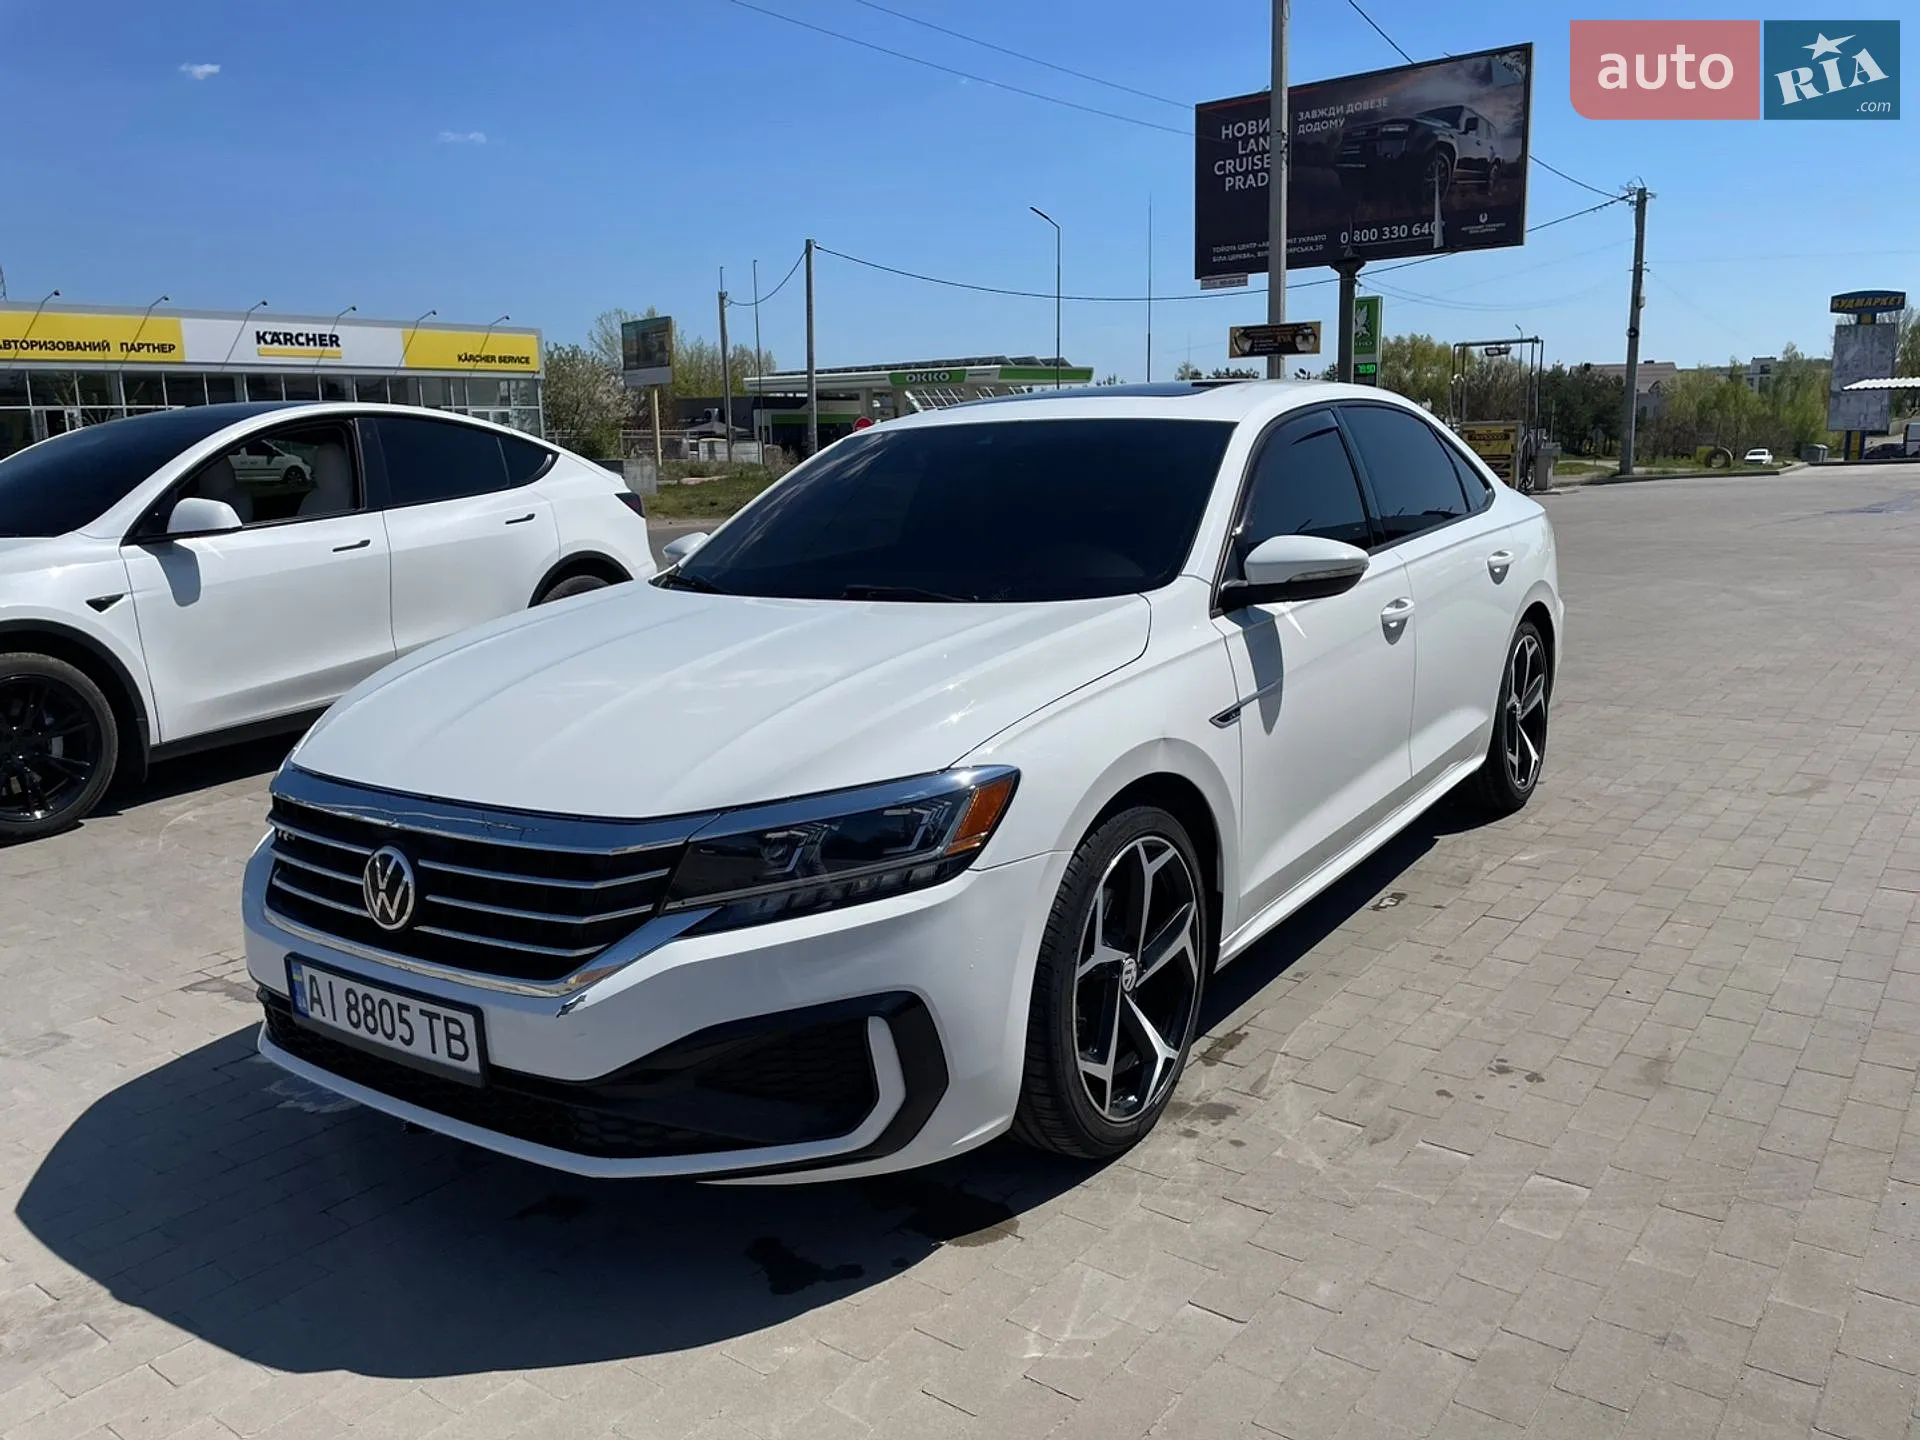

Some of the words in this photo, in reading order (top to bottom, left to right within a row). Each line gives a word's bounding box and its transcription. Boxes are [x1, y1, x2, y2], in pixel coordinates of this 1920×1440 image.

[1298, 105, 1344, 121] ЗАВЖДИ
[1346, 97, 1388, 114] ДОВЕЗЕ
[1221, 118, 1270, 140] НОВИ
[1297, 118, 1345, 135] ДОДОМУ
[1238, 135, 1270, 155] LAN
[1214, 153, 1271, 175] CRUISE
[1225, 172, 1269, 192] PRAD
[1340, 231, 1349, 244] 0
[1353, 228, 1378, 242] 800
[1382, 225, 1408, 239] 330
[120, 342, 176, 353] ПАРТНЕР
[255, 330, 341, 347] KÄRCHER
[457, 352, 496, 364] KÄRCHER
[498, 354, 530, 365] SERVICE
[906, 371, 950, 383] OKKO
[308, 974, 337, 1021] AI
[345, 988, 414, 1047] 8805
[418, 1009, 470, 1062] TB
